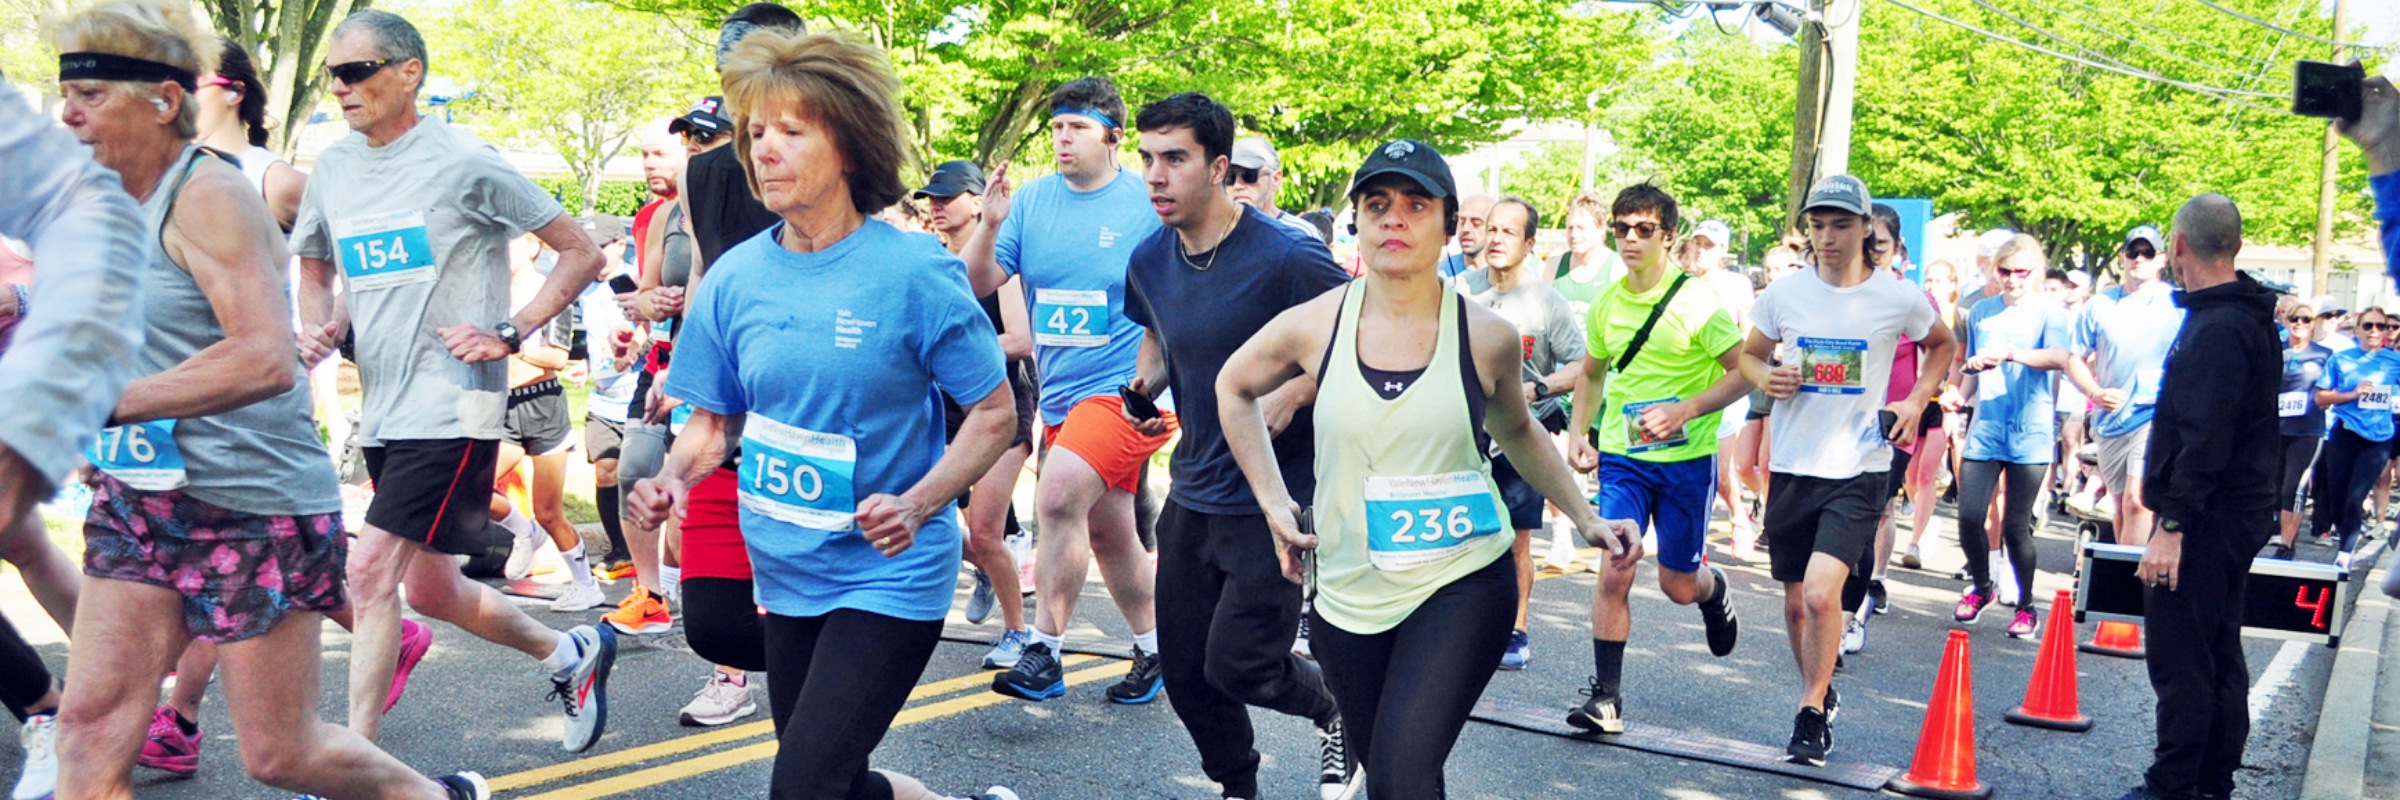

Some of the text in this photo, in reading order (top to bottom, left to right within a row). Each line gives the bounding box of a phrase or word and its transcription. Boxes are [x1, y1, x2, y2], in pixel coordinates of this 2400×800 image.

[352, 235, 410, 271] 154
[1047, 306, 1091, 336] 42
[1815, 362, 1846, 384] 639
[2362, 391, 2389, 404] 2482
[755, 453, 823, 502] 150
[1390, 505, 1475, 543] 236
[2295, 585, 2330, 629] 4
